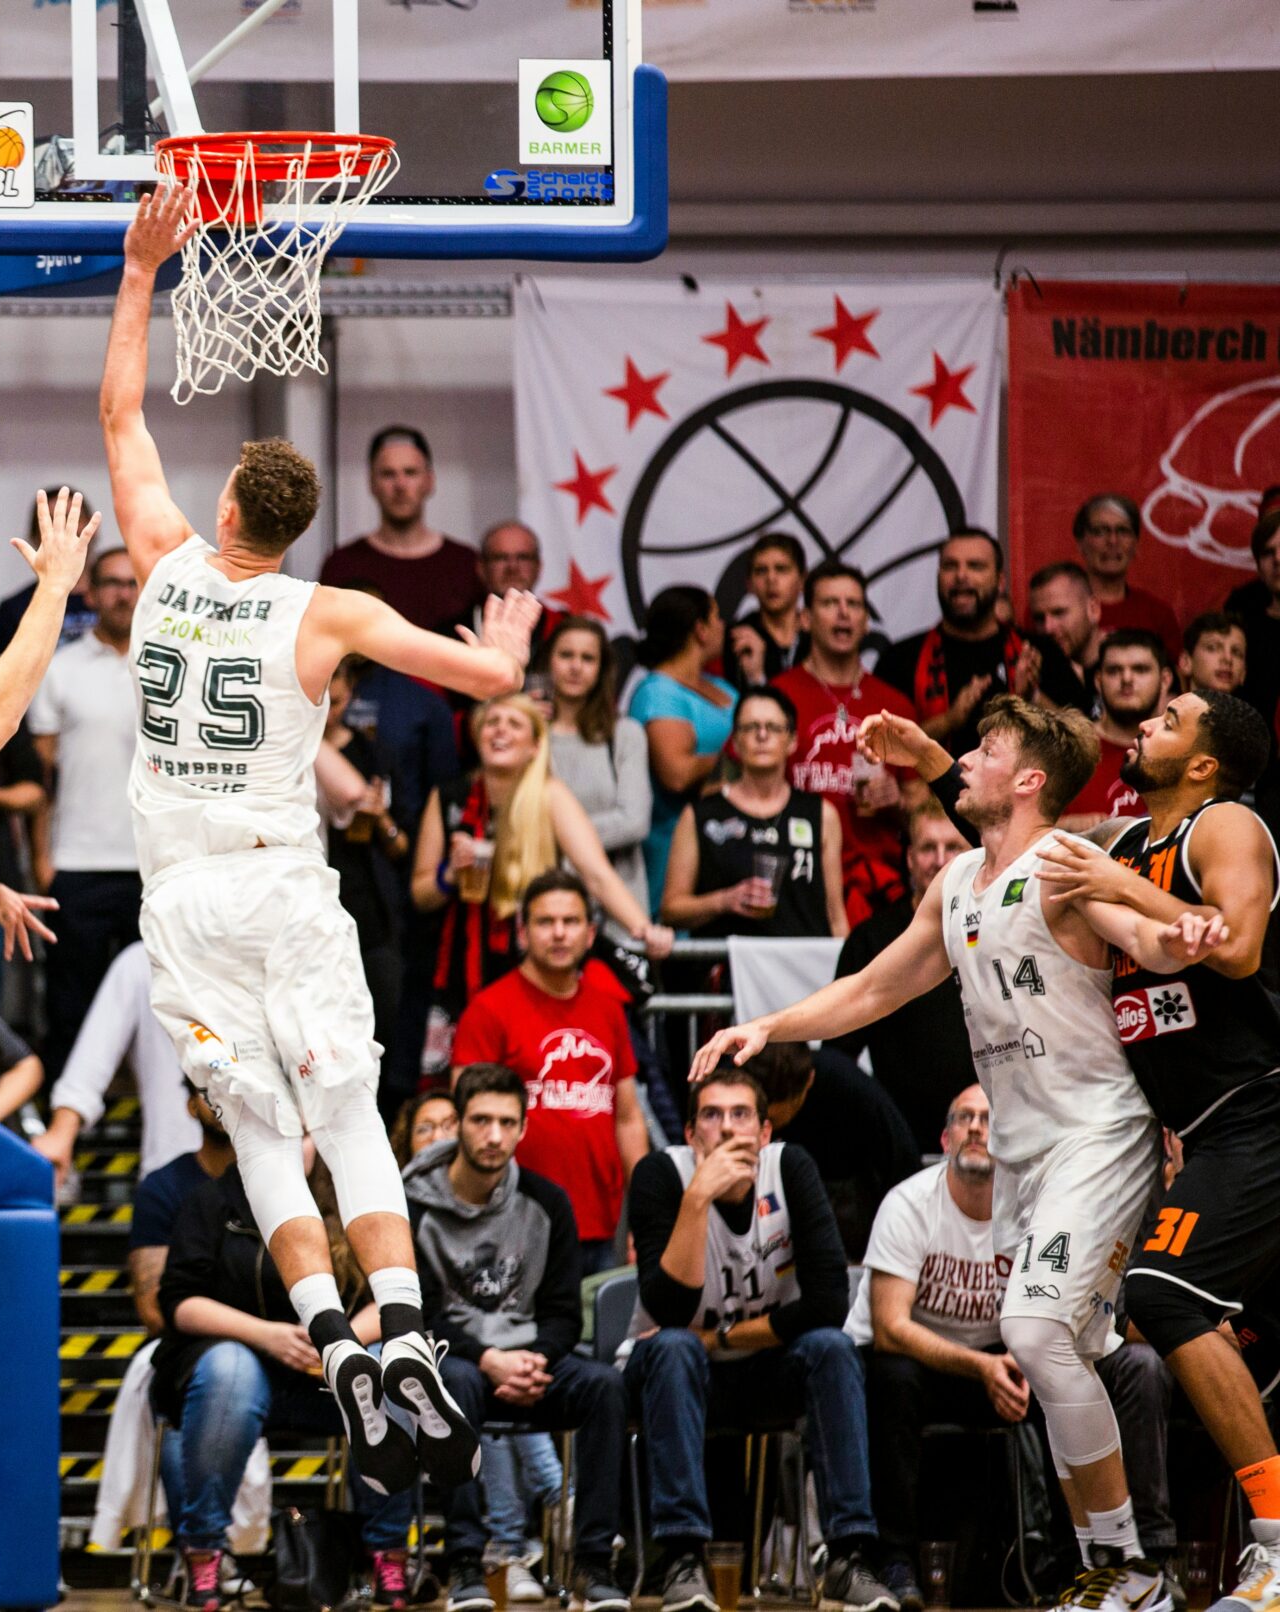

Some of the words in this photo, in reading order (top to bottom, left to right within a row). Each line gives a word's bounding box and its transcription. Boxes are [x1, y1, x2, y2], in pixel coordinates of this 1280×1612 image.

[528, 141, 602, 155] BARMER
[526, 169, 613, 185] Schelde
[526, 185, 613, 203] Sports
[1052, 316, 1267, 362] Nämberch
[136, 641, 265, 751] 25
[992, 955, 1046, 1001] 14
[1020, 1231, 1070, 1274] 14
[1143, 1207, 1200, 1258] 31
[721, 1265, 765, 1303] 11
[917, 1284, 997, 1321] ALCONS
